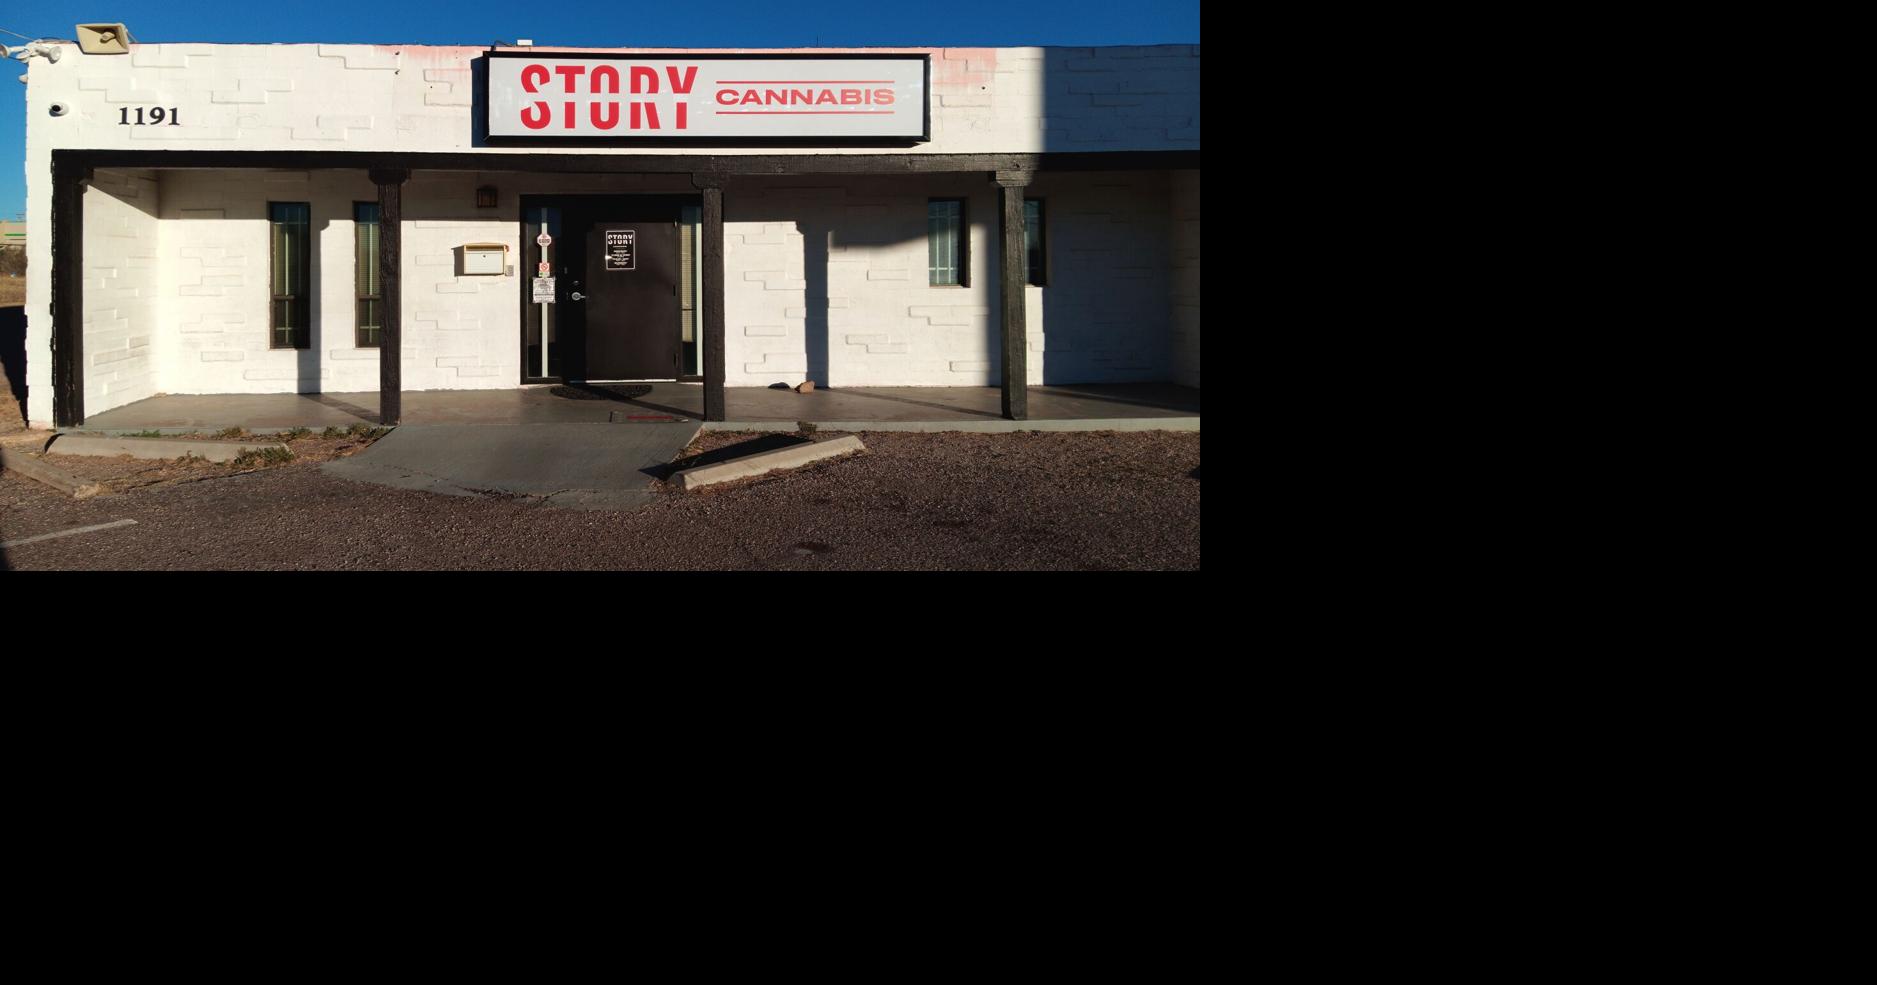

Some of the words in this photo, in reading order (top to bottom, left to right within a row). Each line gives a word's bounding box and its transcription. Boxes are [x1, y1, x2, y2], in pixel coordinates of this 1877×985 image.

[520, 64, 698, 130] STORY
[715, 88, 895, 106] CANNABIS
[118, 106, 180, 126] 1191
[607, 234, 633, 245] STORY
